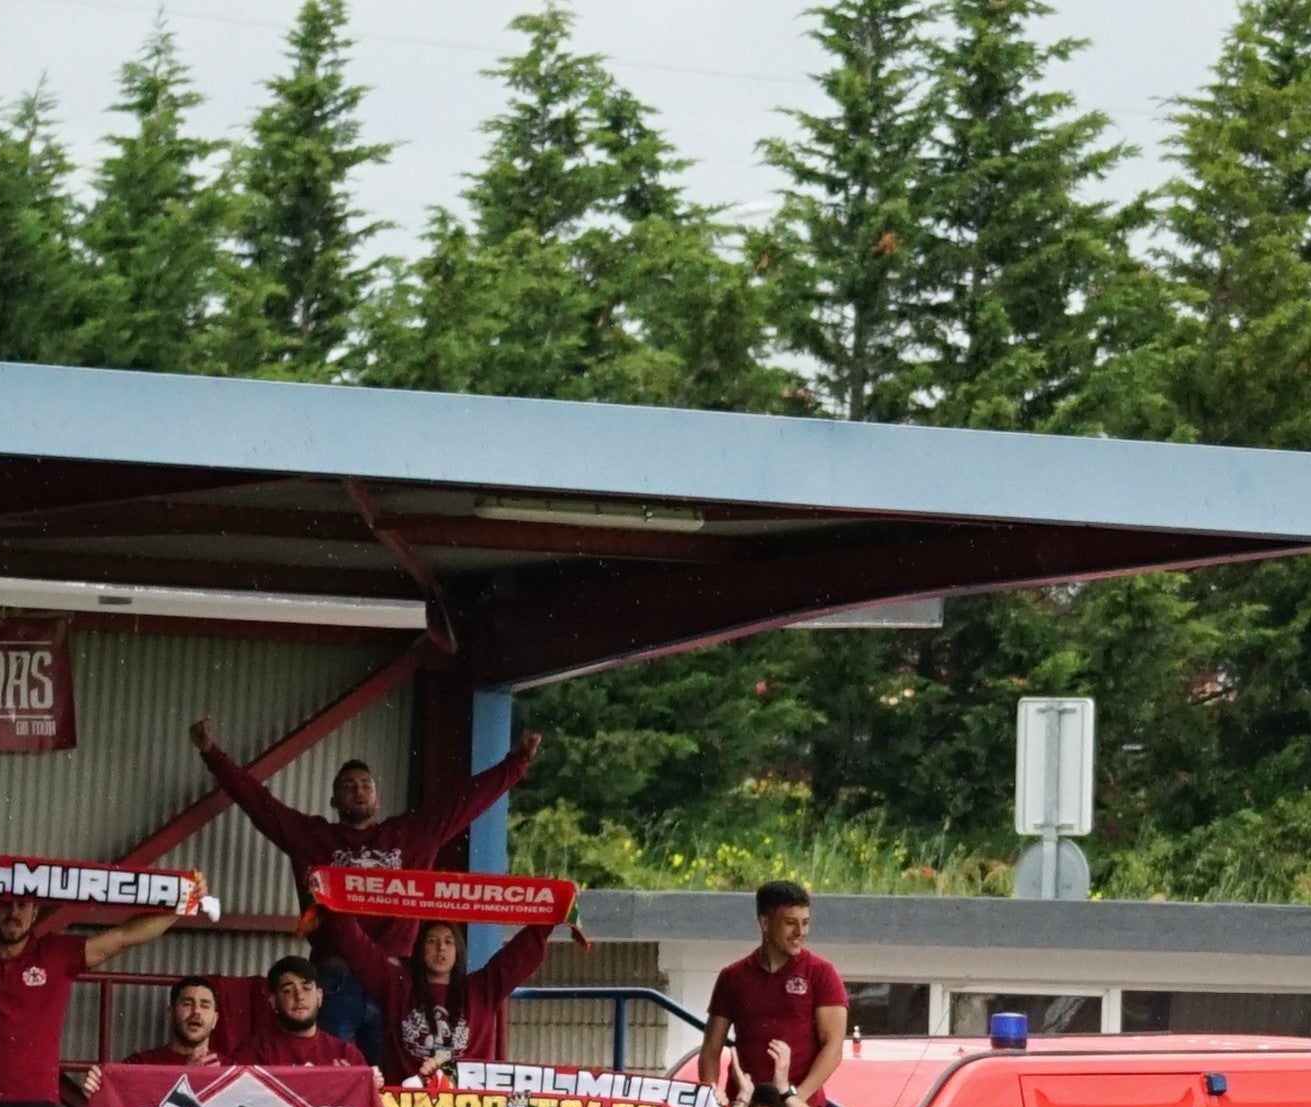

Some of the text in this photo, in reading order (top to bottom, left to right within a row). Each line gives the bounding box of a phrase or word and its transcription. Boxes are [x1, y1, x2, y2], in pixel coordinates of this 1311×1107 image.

[12, 862, 181, 906] MURCIA
[345, 875, 556, 904] REAL MURCIA
[368, 894, 400, 906] AÑOS
[403, 899, 417, 907] DE
[420, 900, 470, 911] ORGULLO
[473, 904, 554, 914] PIMENTONERO
